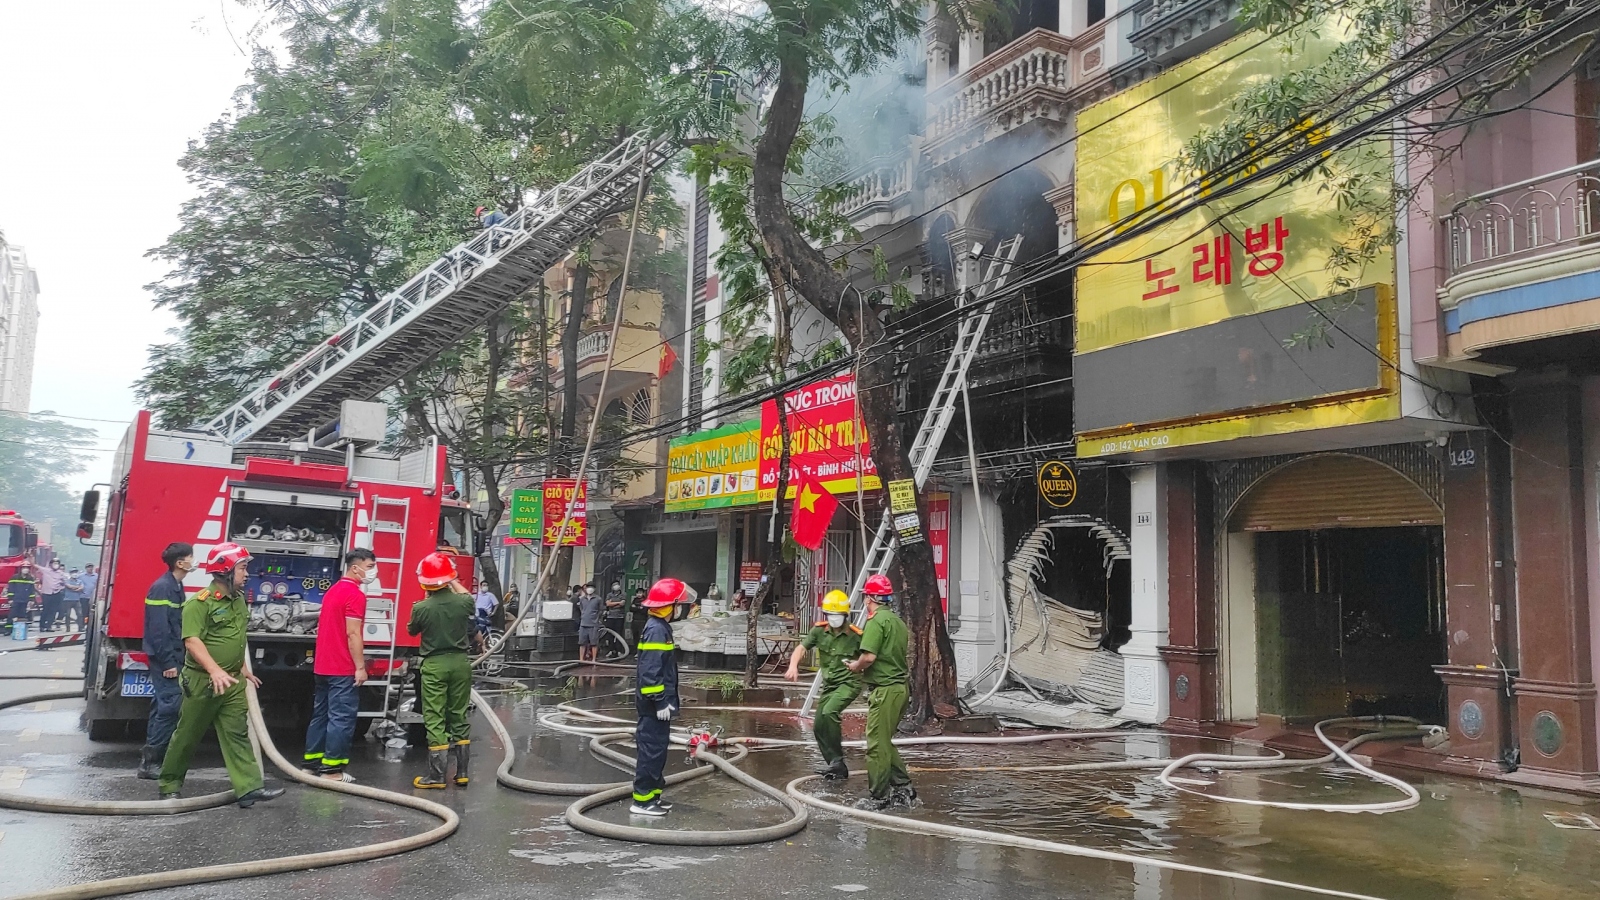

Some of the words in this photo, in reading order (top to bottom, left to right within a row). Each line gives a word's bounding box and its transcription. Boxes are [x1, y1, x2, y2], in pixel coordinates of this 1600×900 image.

[1142, 216, 1289, 300] 노래방
[808, 419, 833, 453] BÁT
[1101, 442, 1118, 453] ADD:
[1119, 440, 1131, 450] 142
[1151, 435, 1169, 446] CAO
[705, 444, 729, 471] NHẬP
[1450, 449, 1475, 465] 142
[818, 462, 839, 476] BÌNH
[545, 484, 562, 499] GIỎ
[1042, 479, 1073, 493] QUEEN
[1137, 514, 1149, 523] 144
[134, 673, 153, 683] 15A
[123, 684, 156, 695] 008.2
